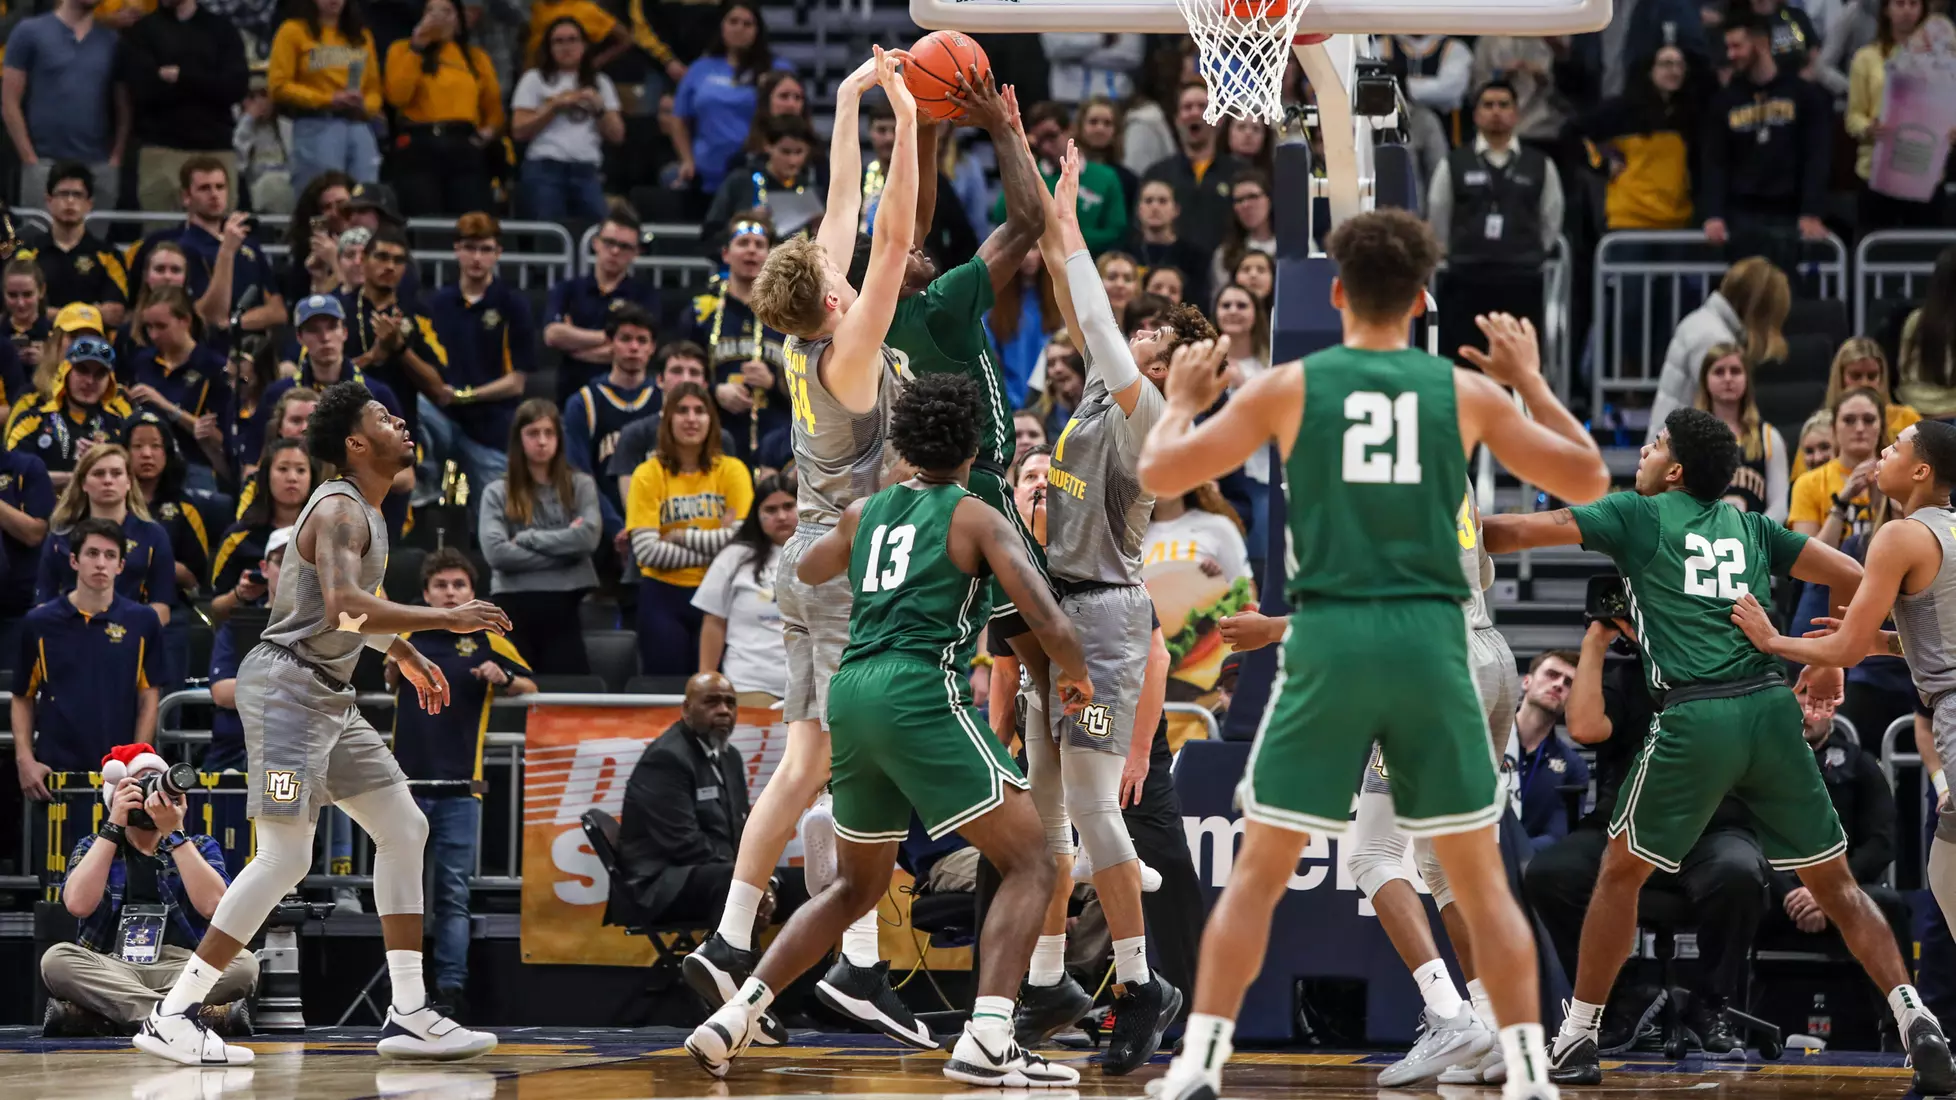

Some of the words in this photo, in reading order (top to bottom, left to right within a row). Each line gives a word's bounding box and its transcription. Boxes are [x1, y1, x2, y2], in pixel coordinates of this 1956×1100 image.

[1342, 391, 1422, 484] 21
[862, 524, 917, 592] 13
[1684, 532, 1750, 601] 22
[1076, 702, 1114, 739] MU
[265, 770, 301, 803] MU
